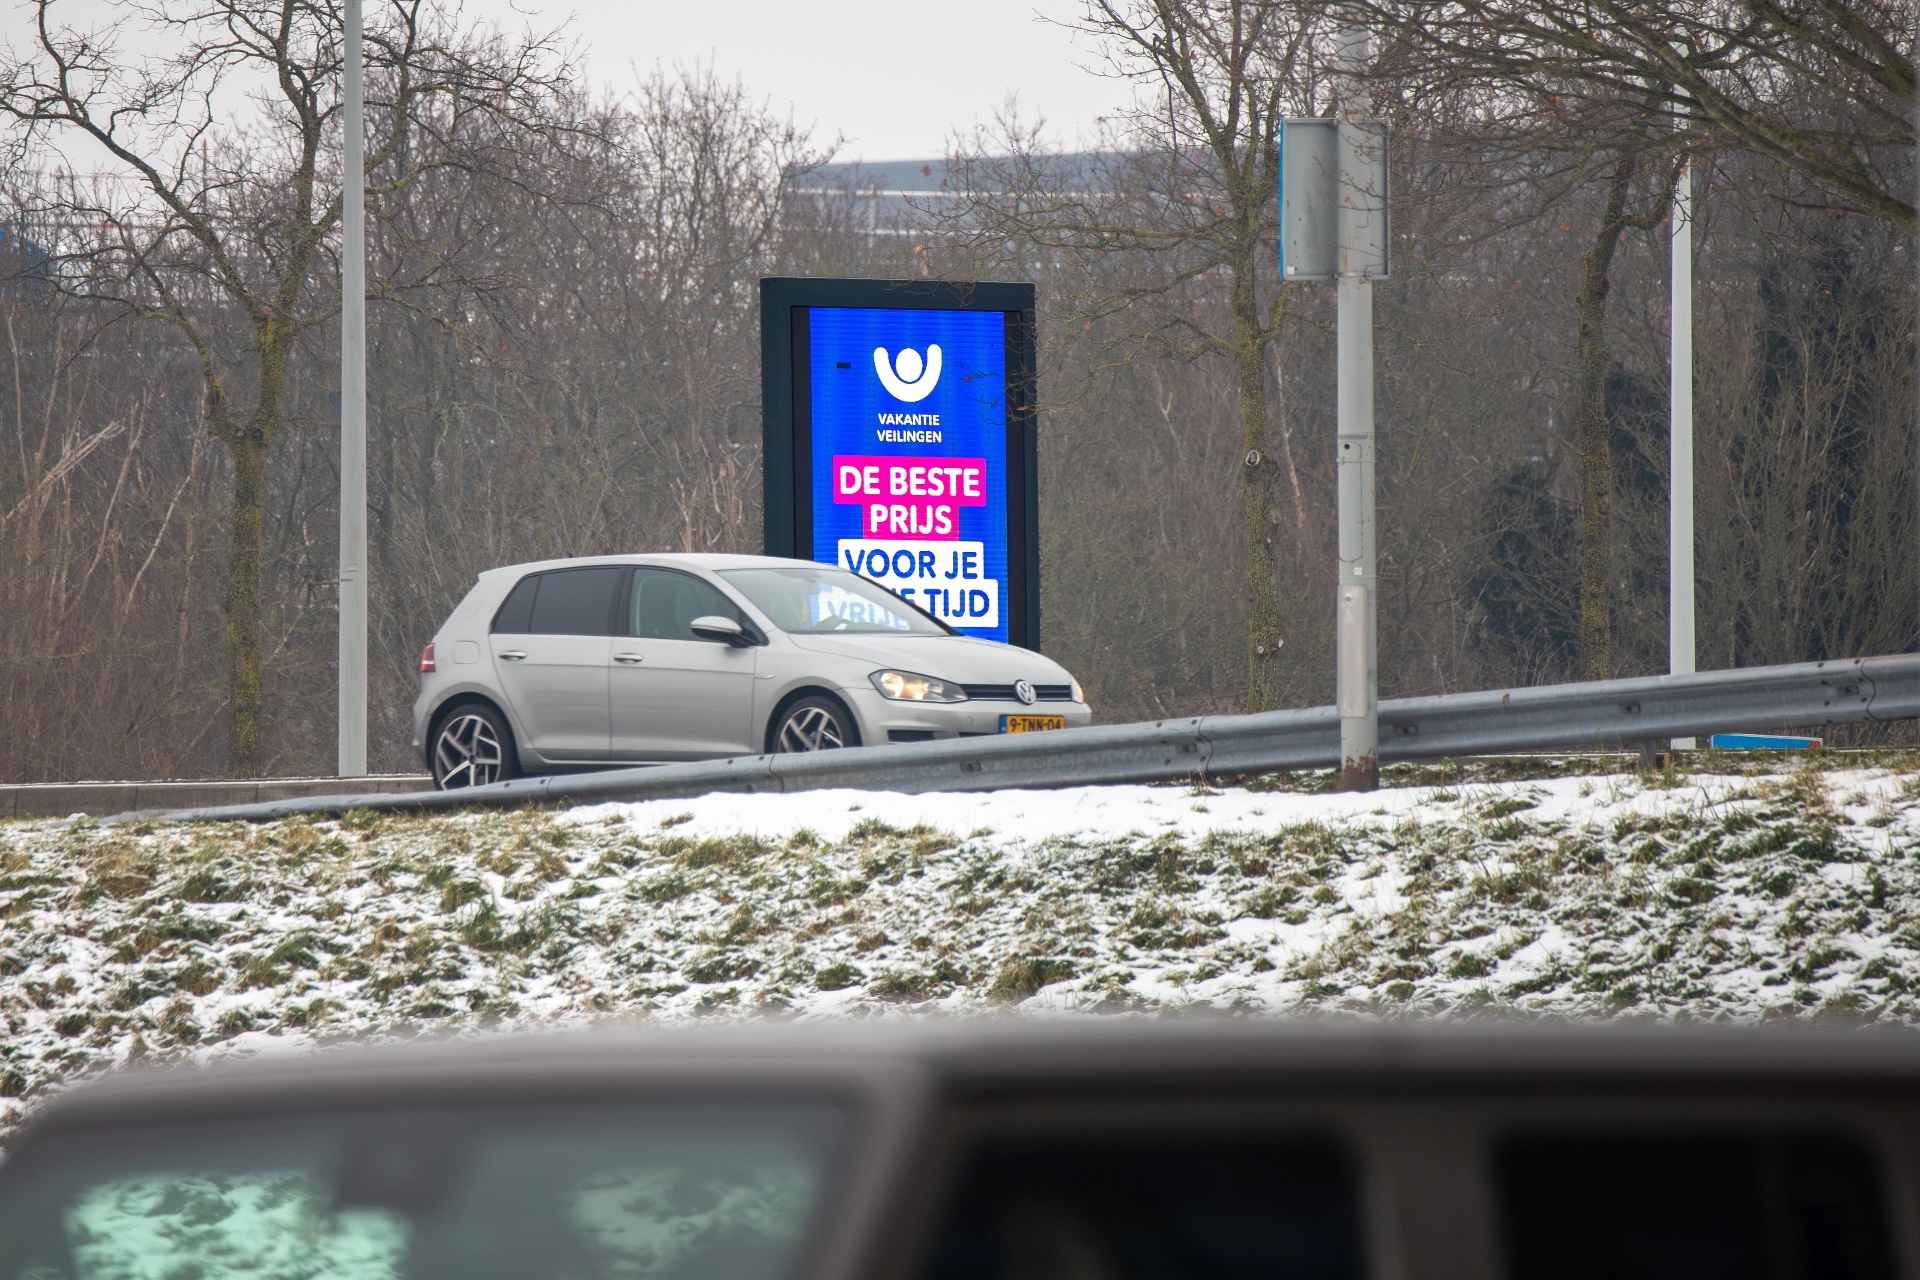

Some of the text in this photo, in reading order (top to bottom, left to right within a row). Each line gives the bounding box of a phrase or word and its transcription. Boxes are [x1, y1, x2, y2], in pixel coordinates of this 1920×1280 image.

[878, 413, 940, 427] VAKANTIE
[876, 429, 943, 444] VEILINGEN
[839, 465, 981, 497] DE BESTE
[870, 504, 952, 535] PRIJS
[844, 548, 978, 580] VOOR JE
[924, 588, 990, 618] TIJD
